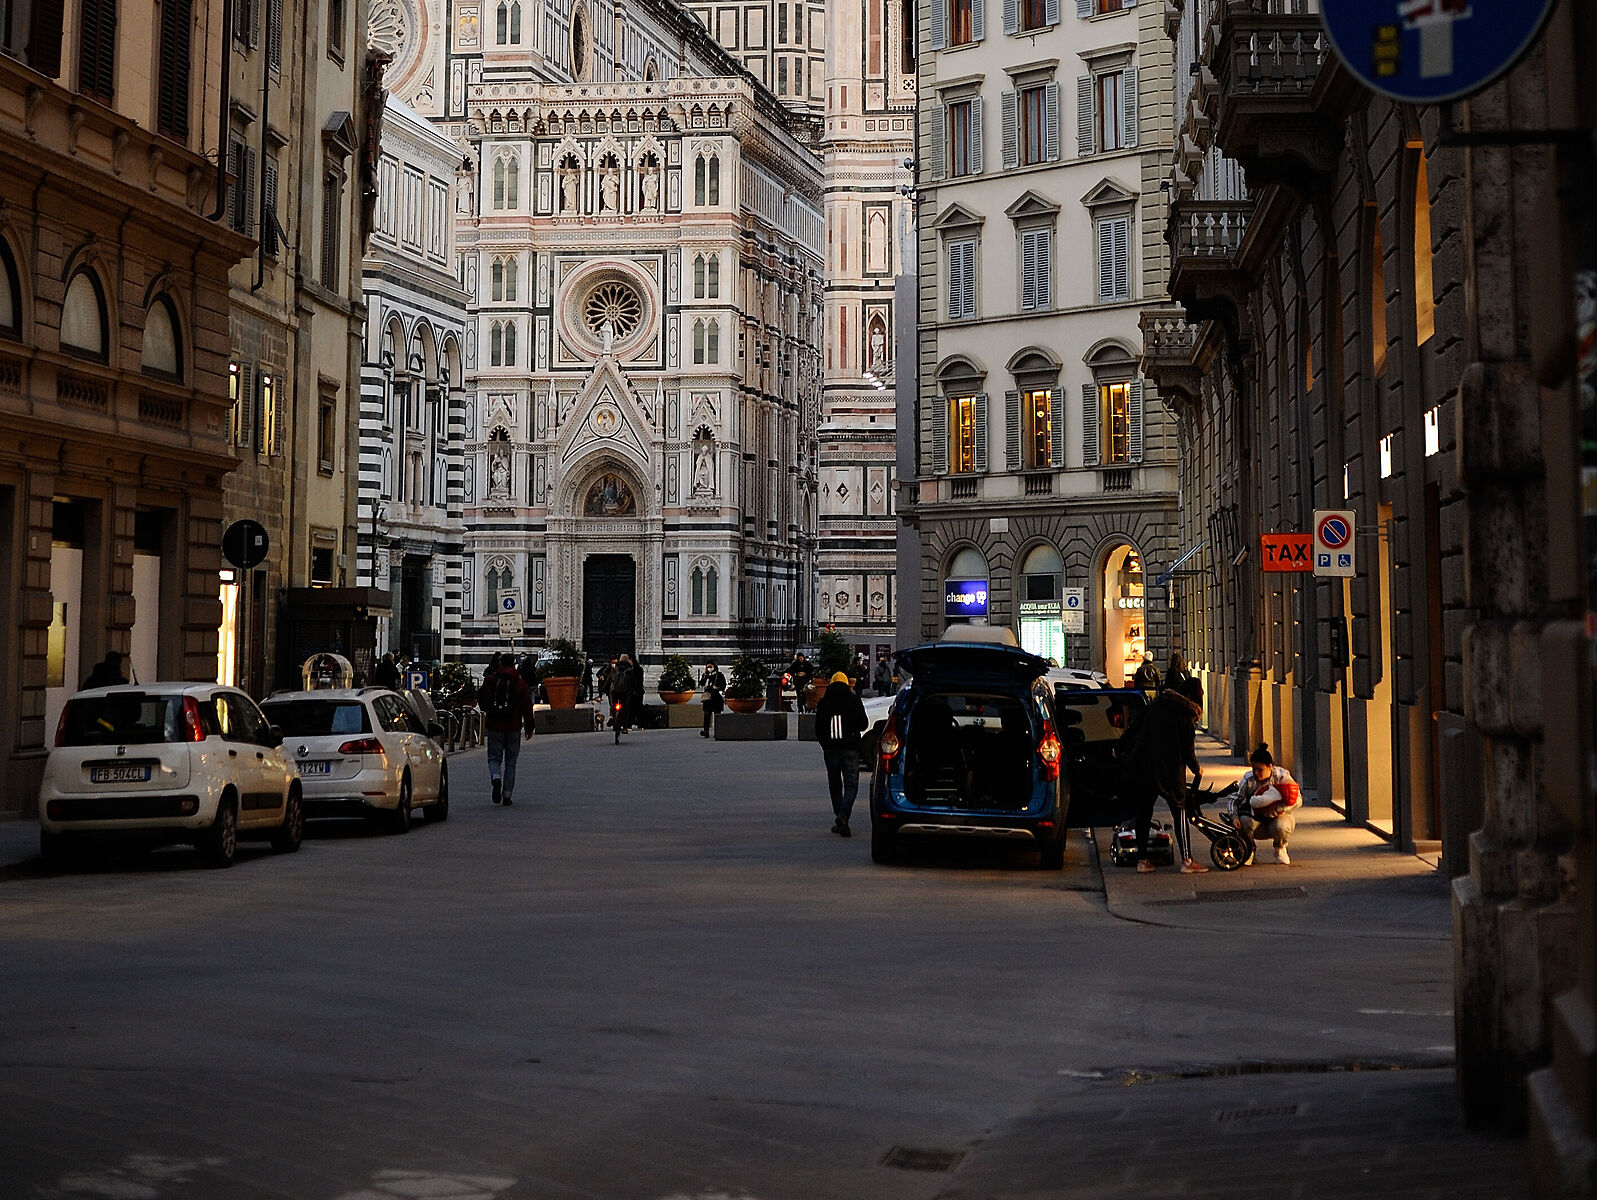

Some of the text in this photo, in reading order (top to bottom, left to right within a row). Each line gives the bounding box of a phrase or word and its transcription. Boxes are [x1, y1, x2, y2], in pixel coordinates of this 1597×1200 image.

[1265, 543, 1313, 561] TAXI
[1320, 555, 1329, 566] P
[946, 592, 975, 605] change
[410, 673, 424, 690] P
